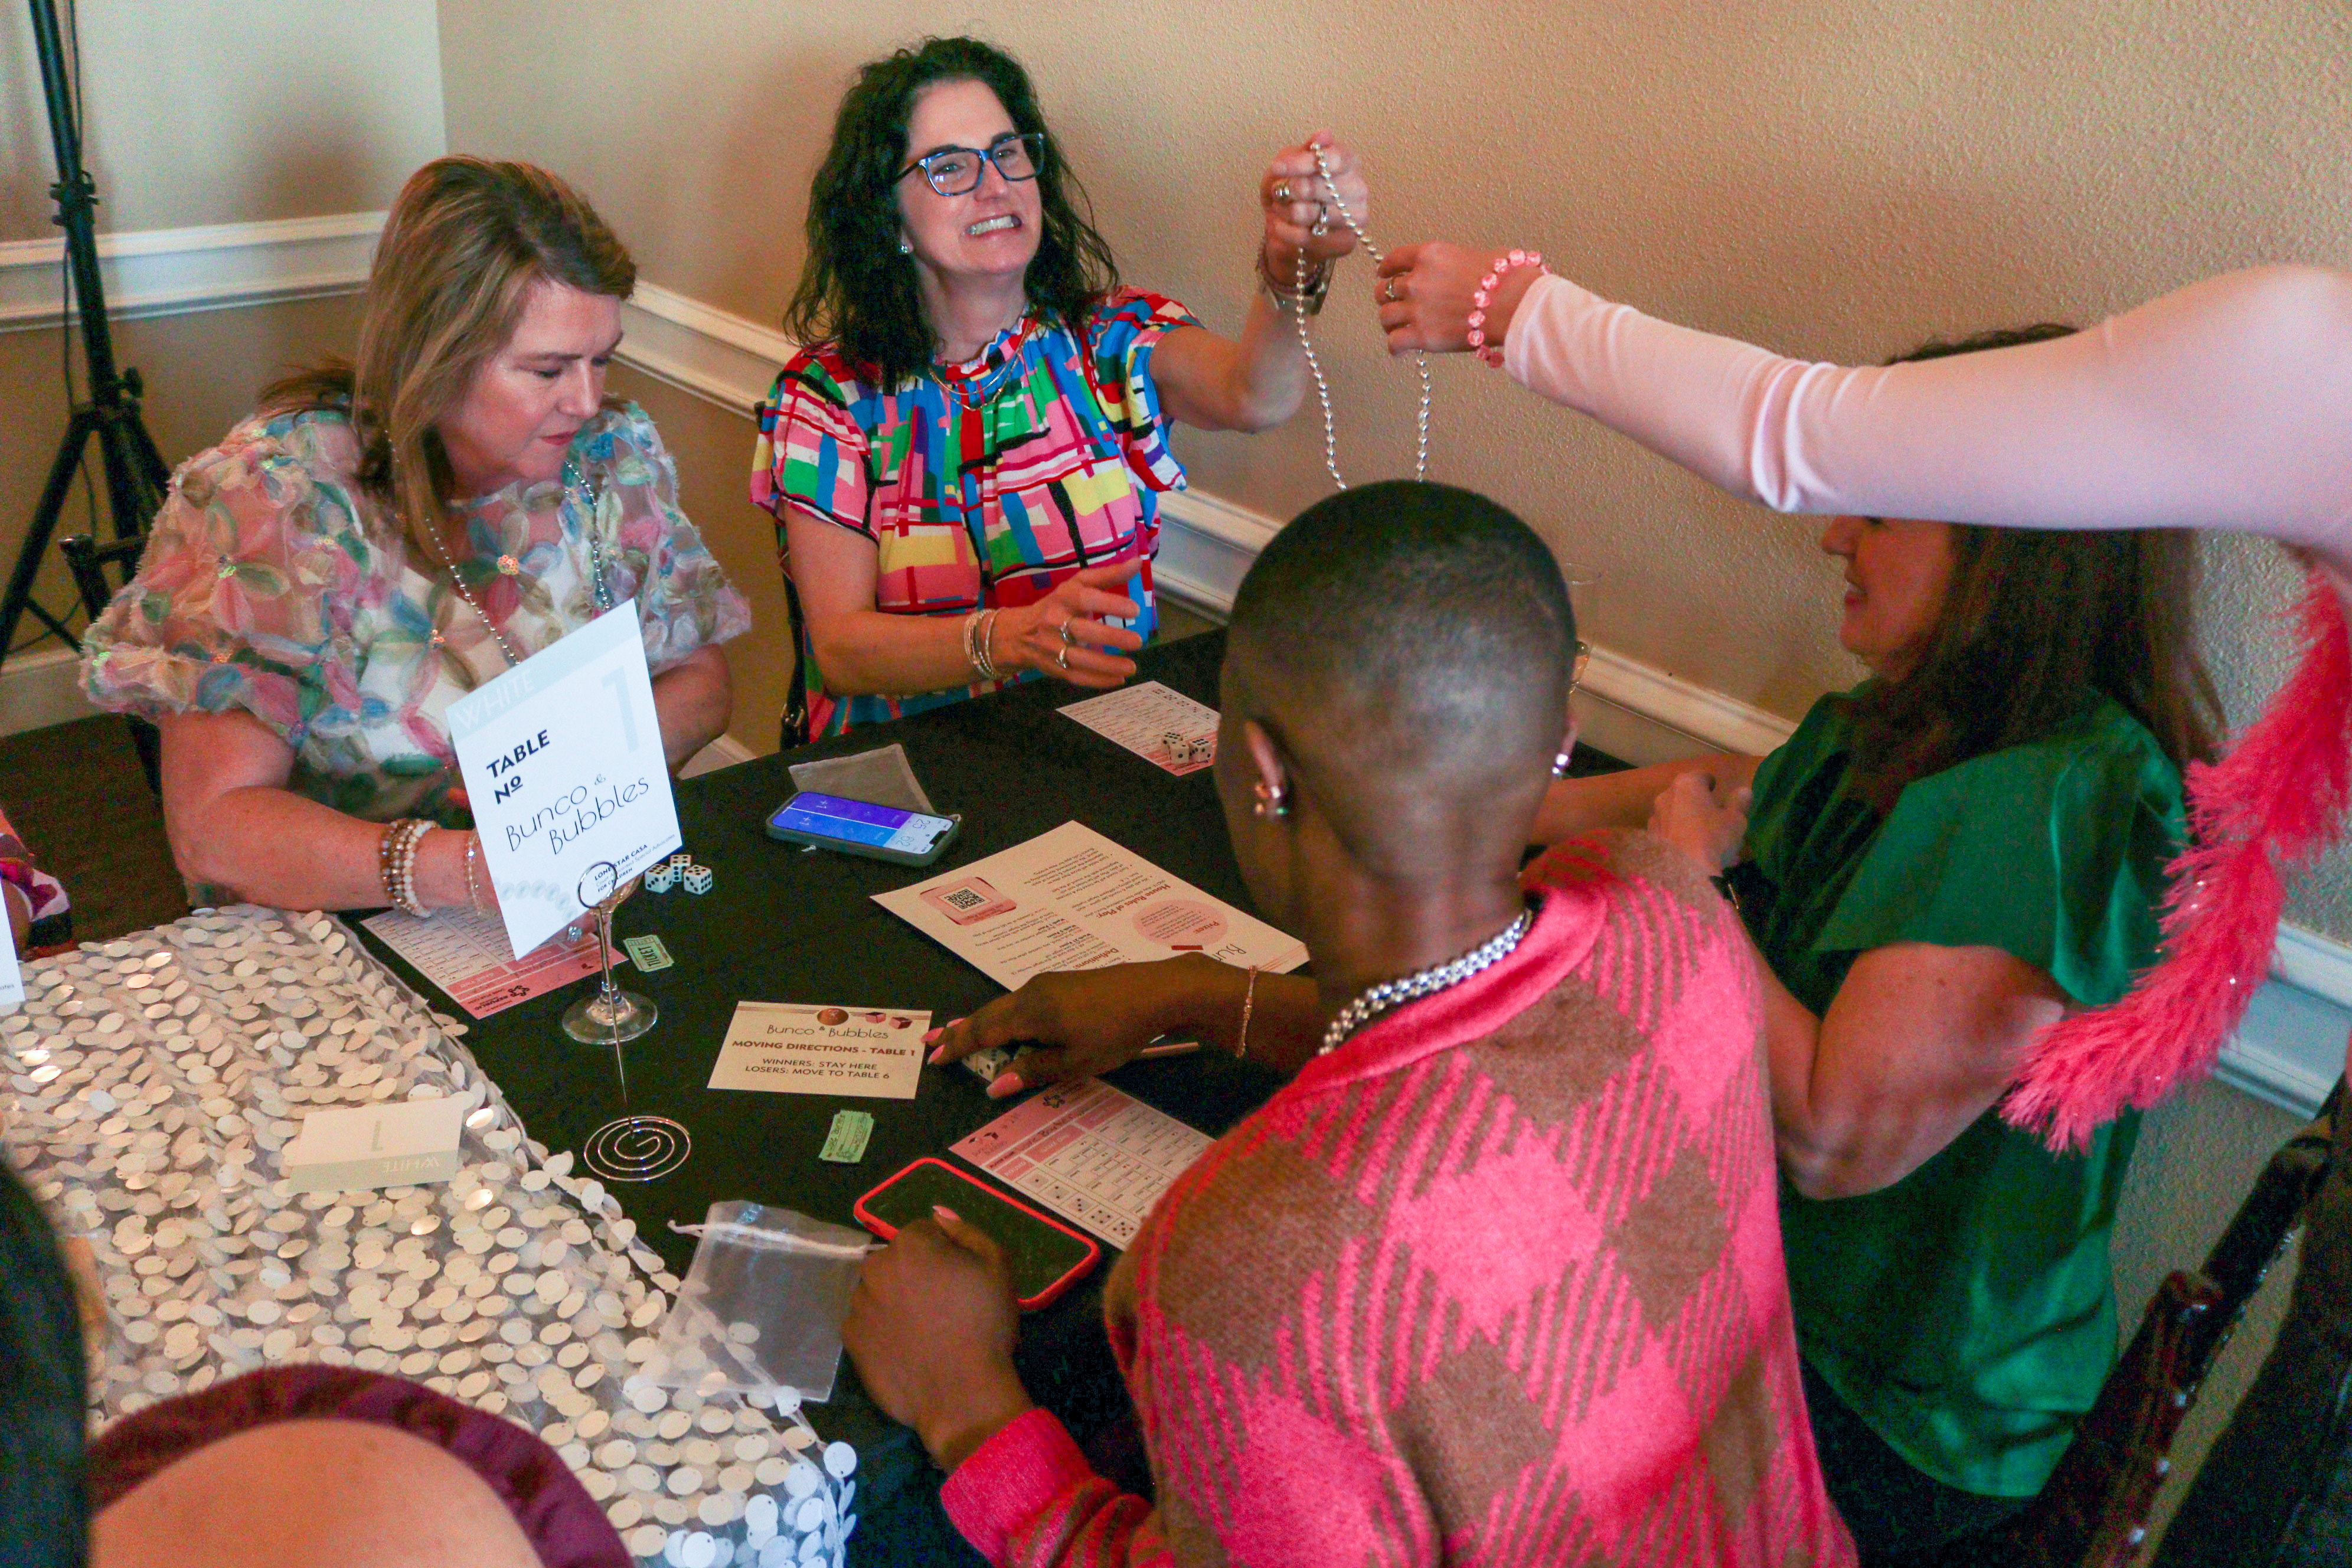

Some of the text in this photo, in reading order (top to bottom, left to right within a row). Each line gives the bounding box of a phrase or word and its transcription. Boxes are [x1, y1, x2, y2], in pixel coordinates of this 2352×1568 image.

[455, 669, 535, 729] WHITE
[600, 665, 639, 753] 1
[486, 729, 550, 778] TABLE
[506, 773, 606, 851] Bunco &
[550, 778, 648, 855] Bubbles
[635, 850, 652, 862] Special
[652, 834, 675, 850] Advocates
[594, 844, 648, 880] LONE STAR CASA
[597, 883, 607, 893] FOR
[1145, 884, 1171, 897] House
[1124, 896, 1147, 906] Rules
[638, 946, 662, 966] TICKET
[1073, 948, 1119, 969] Definitions:
[767, 1024, 815, 1035] Bunco
[828, 1027, 889, 1039] Bubbles
[786, 1043, 858, 1053] DIRECTIONS
[870, 1047, 906, 1056] TABLE
[763, 1059, 815, 1067] WINNERS:
